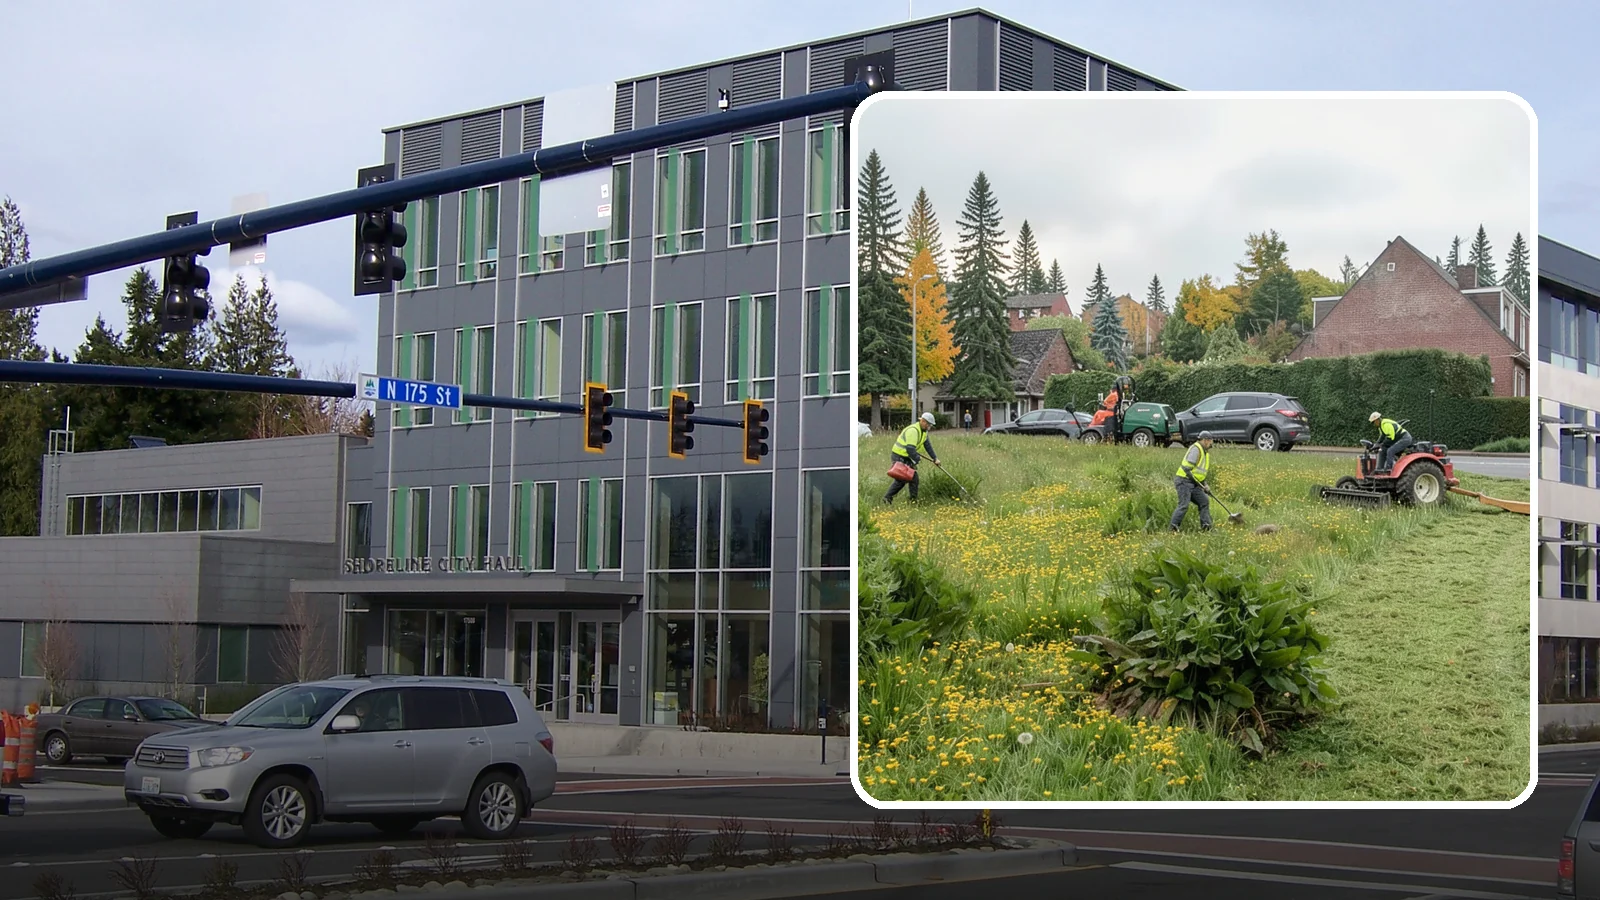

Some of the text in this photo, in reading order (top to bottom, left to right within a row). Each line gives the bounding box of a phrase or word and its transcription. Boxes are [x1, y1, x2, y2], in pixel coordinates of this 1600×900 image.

[387, 380, 451, 406] N 175 St
[344, 555, 526, 574] SHORELINE CITY HALL
